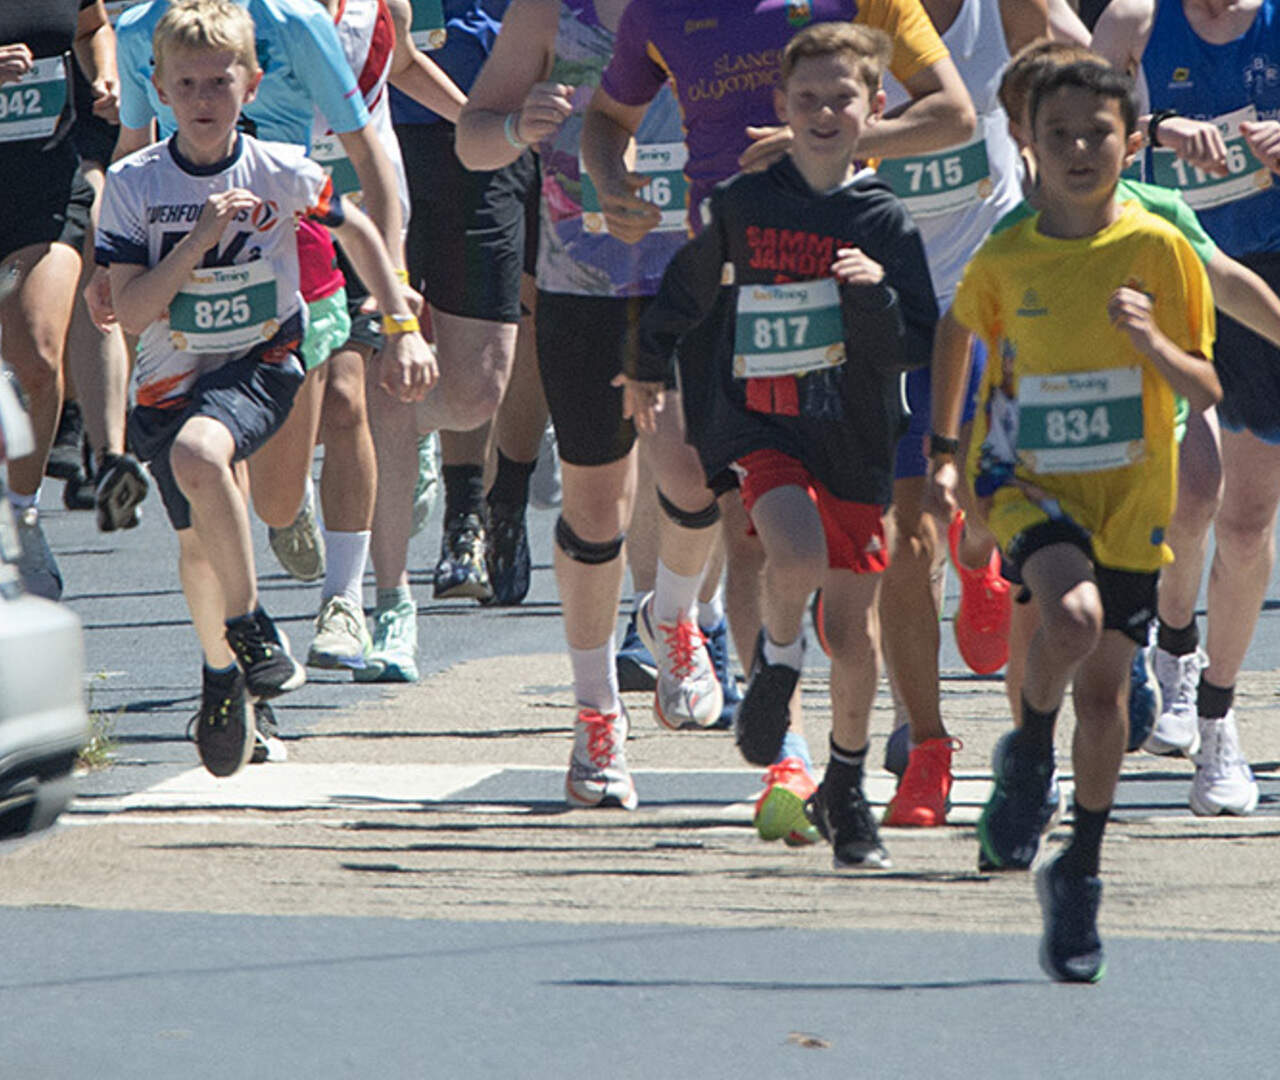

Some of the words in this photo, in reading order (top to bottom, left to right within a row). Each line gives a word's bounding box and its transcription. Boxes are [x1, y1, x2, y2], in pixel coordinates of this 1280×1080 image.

[904, 156, 963, 192] 715
[194, 294, 251, 329] 825
[754, 316, 810, 350] 817
[1045, 405, 1111, 444] 834
